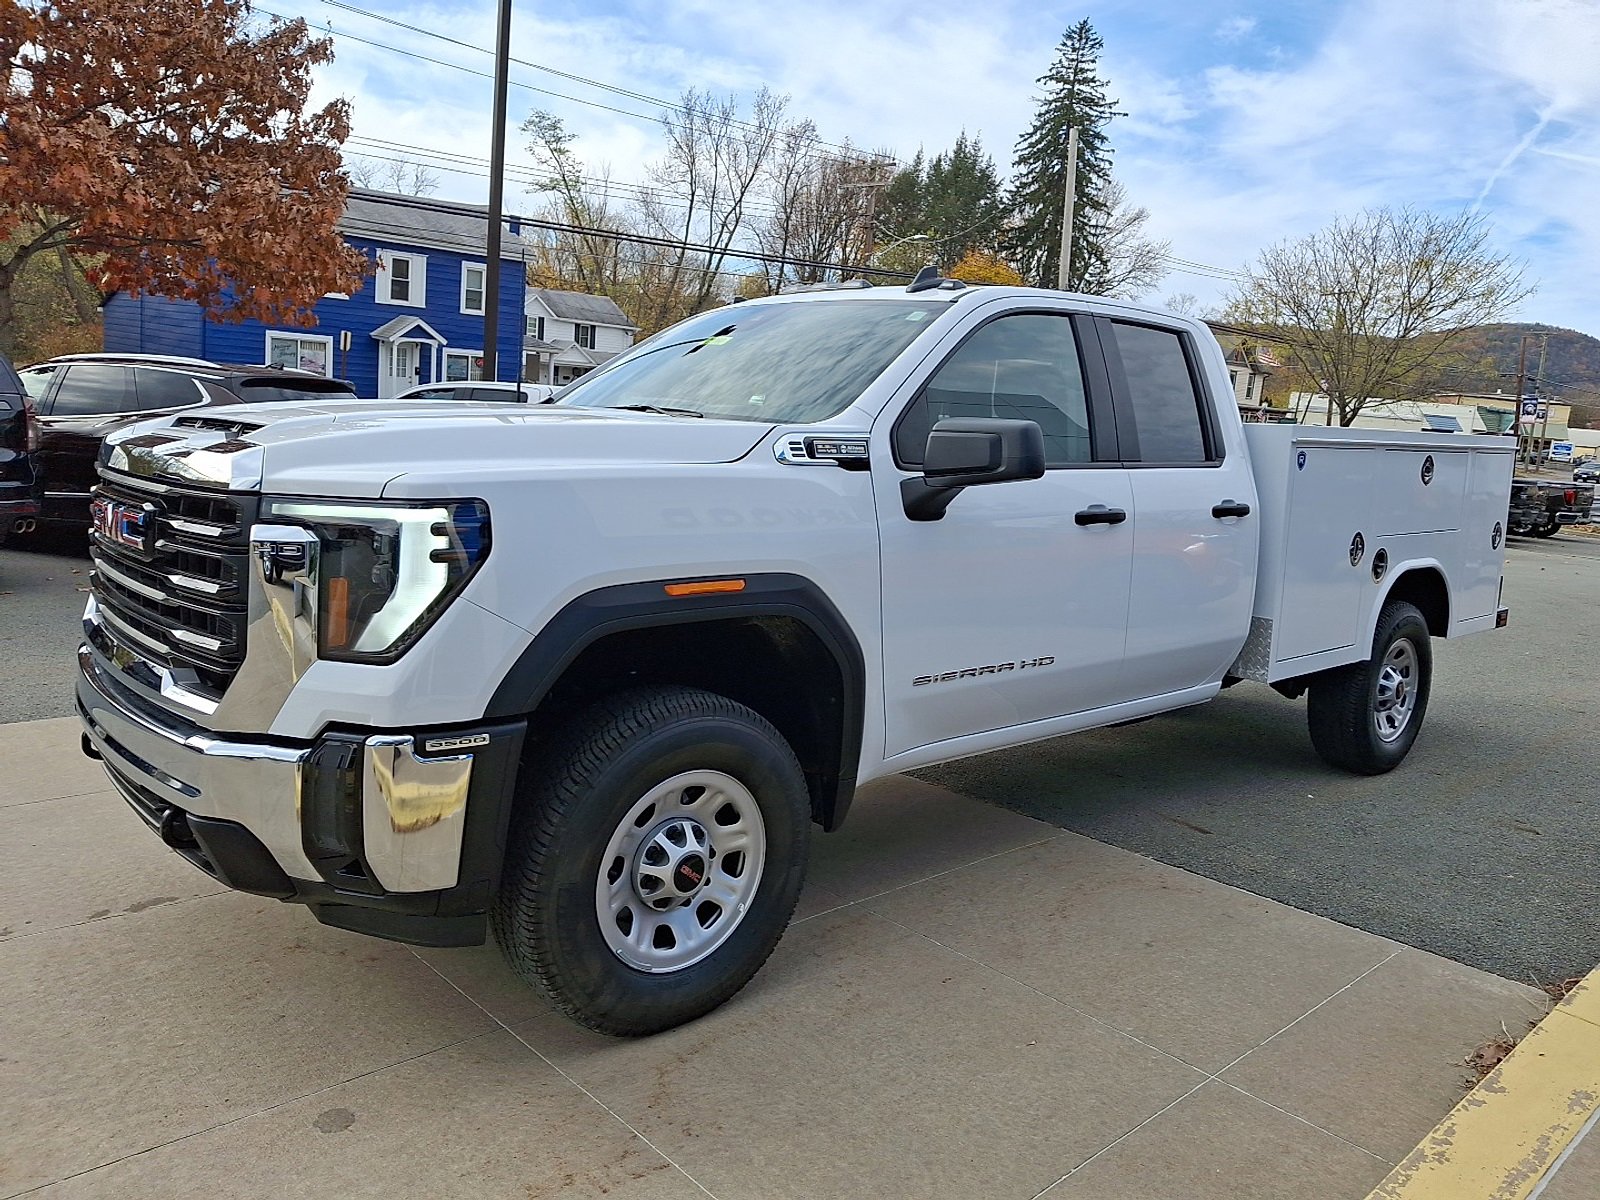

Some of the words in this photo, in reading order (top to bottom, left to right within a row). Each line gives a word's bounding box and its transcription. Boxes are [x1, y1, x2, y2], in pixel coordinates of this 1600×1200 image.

[93, 500, 145, 550] GMC
[912, 660, 1016, 687] SIERRA
[1019, 655, 1056, 669] HD
